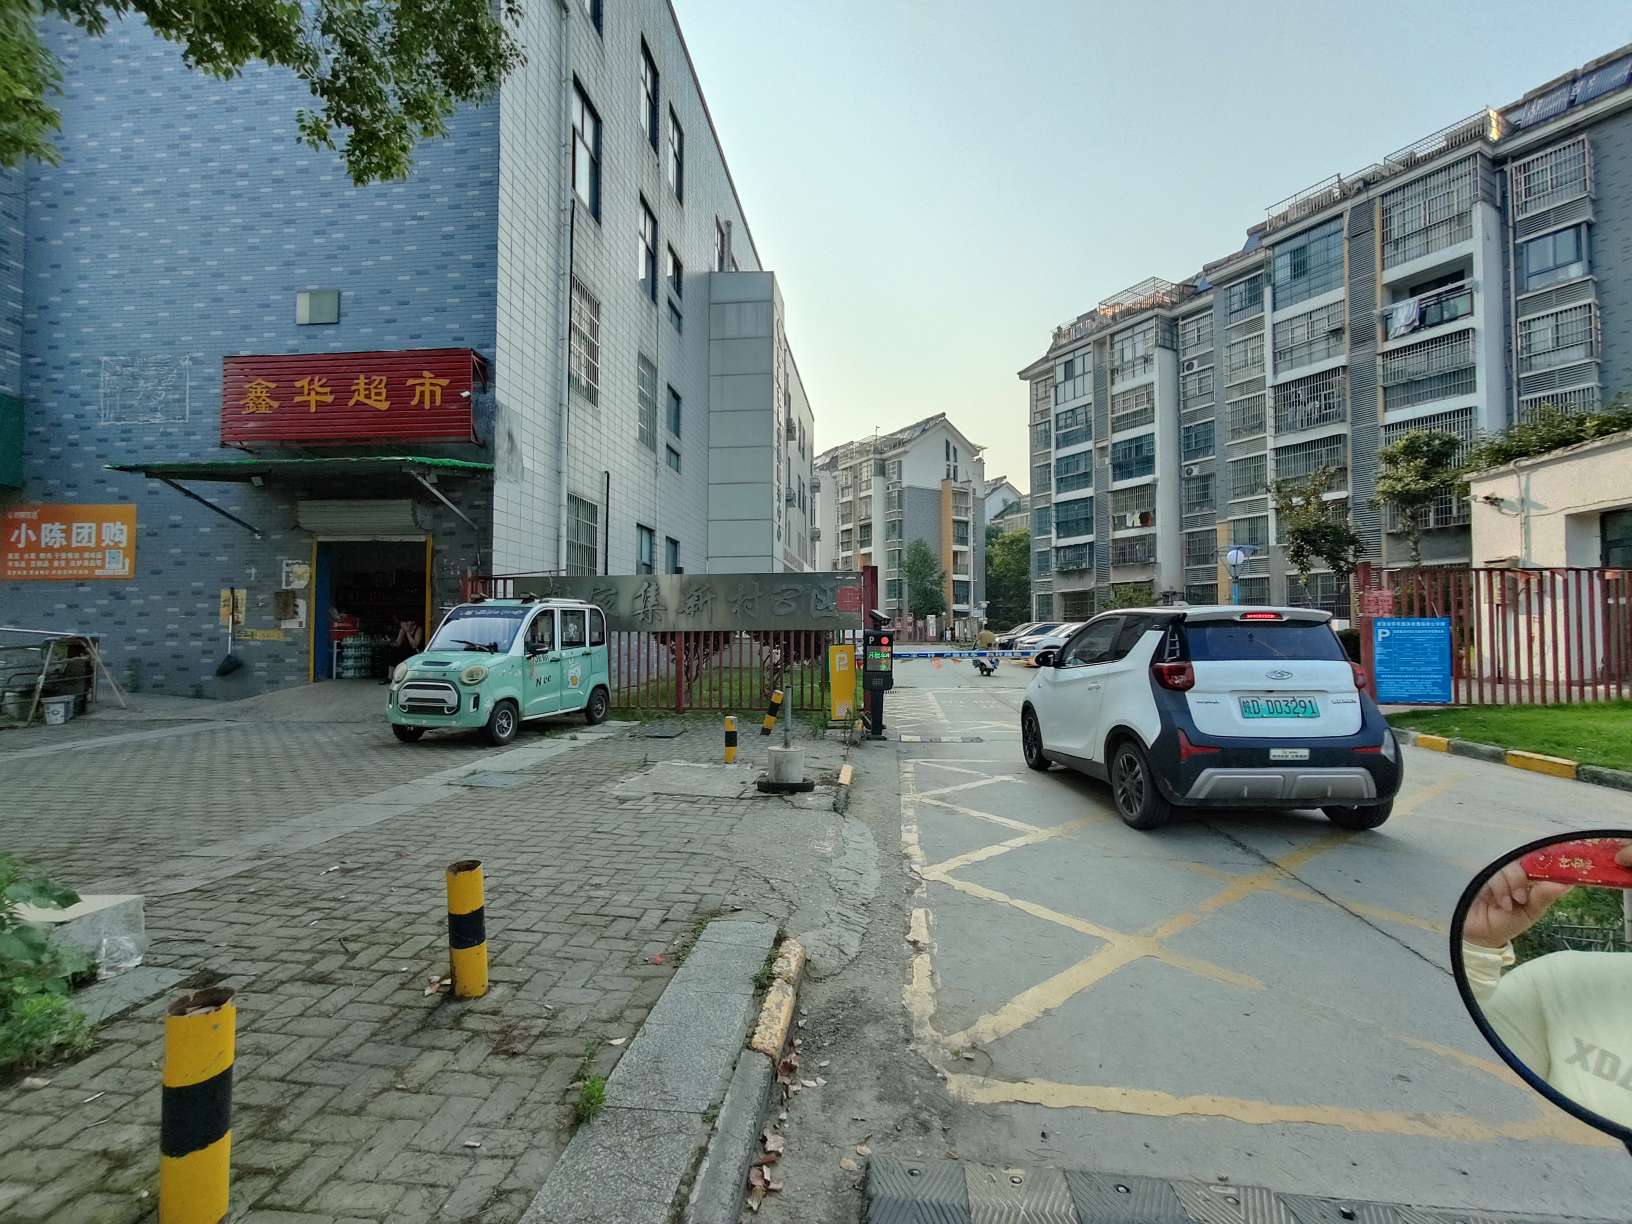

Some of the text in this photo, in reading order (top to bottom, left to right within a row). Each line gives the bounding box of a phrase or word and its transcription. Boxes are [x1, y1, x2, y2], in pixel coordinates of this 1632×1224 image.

[240, 370, 450, 414] 鑫华超市
[10, 521, 128, 548] 小陈团购
[869, 636, 875, 644] P
[1377, 629, 1390, 641] P
